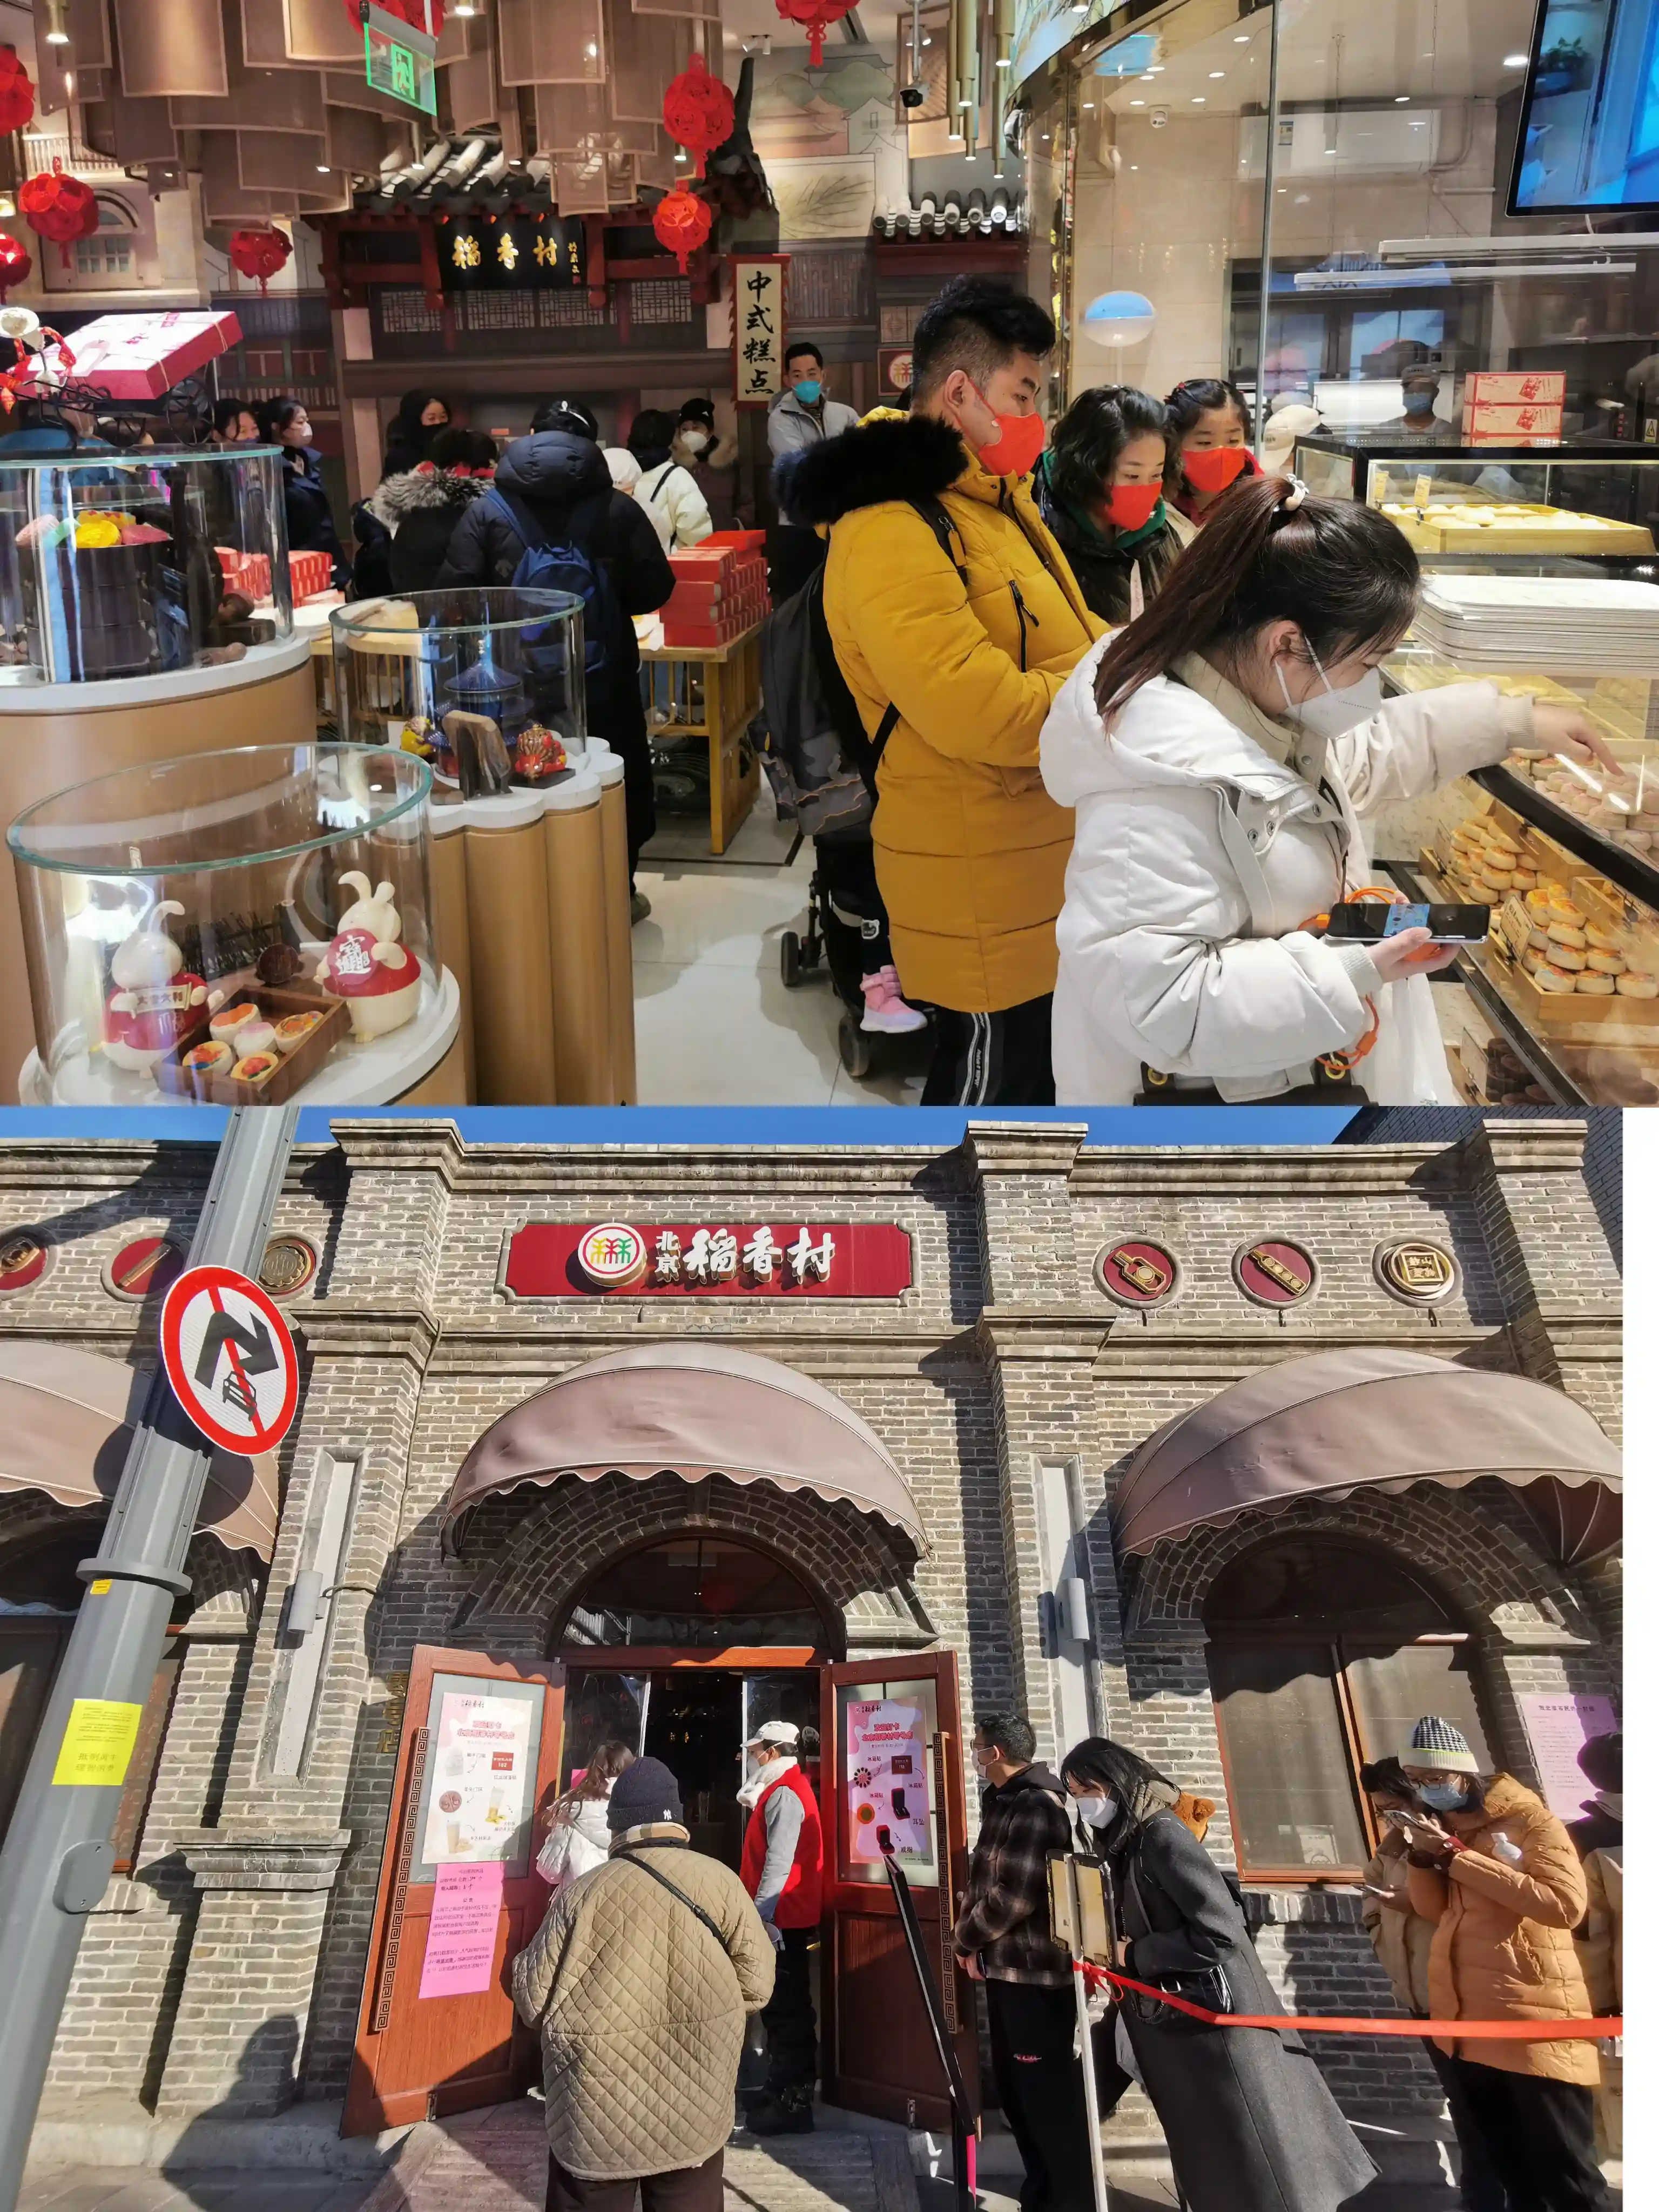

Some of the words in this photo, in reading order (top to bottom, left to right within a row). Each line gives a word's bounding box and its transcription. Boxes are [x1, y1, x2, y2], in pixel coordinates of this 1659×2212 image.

[451, 233, 557, 270] 稻香村
[743, 270, 777, 395] 中式糕点
[655, 1231, 682, 1276] 北京
[683, 1226, 836, 1277] 稻香村
[663, 1809, 672, 1820] NY
